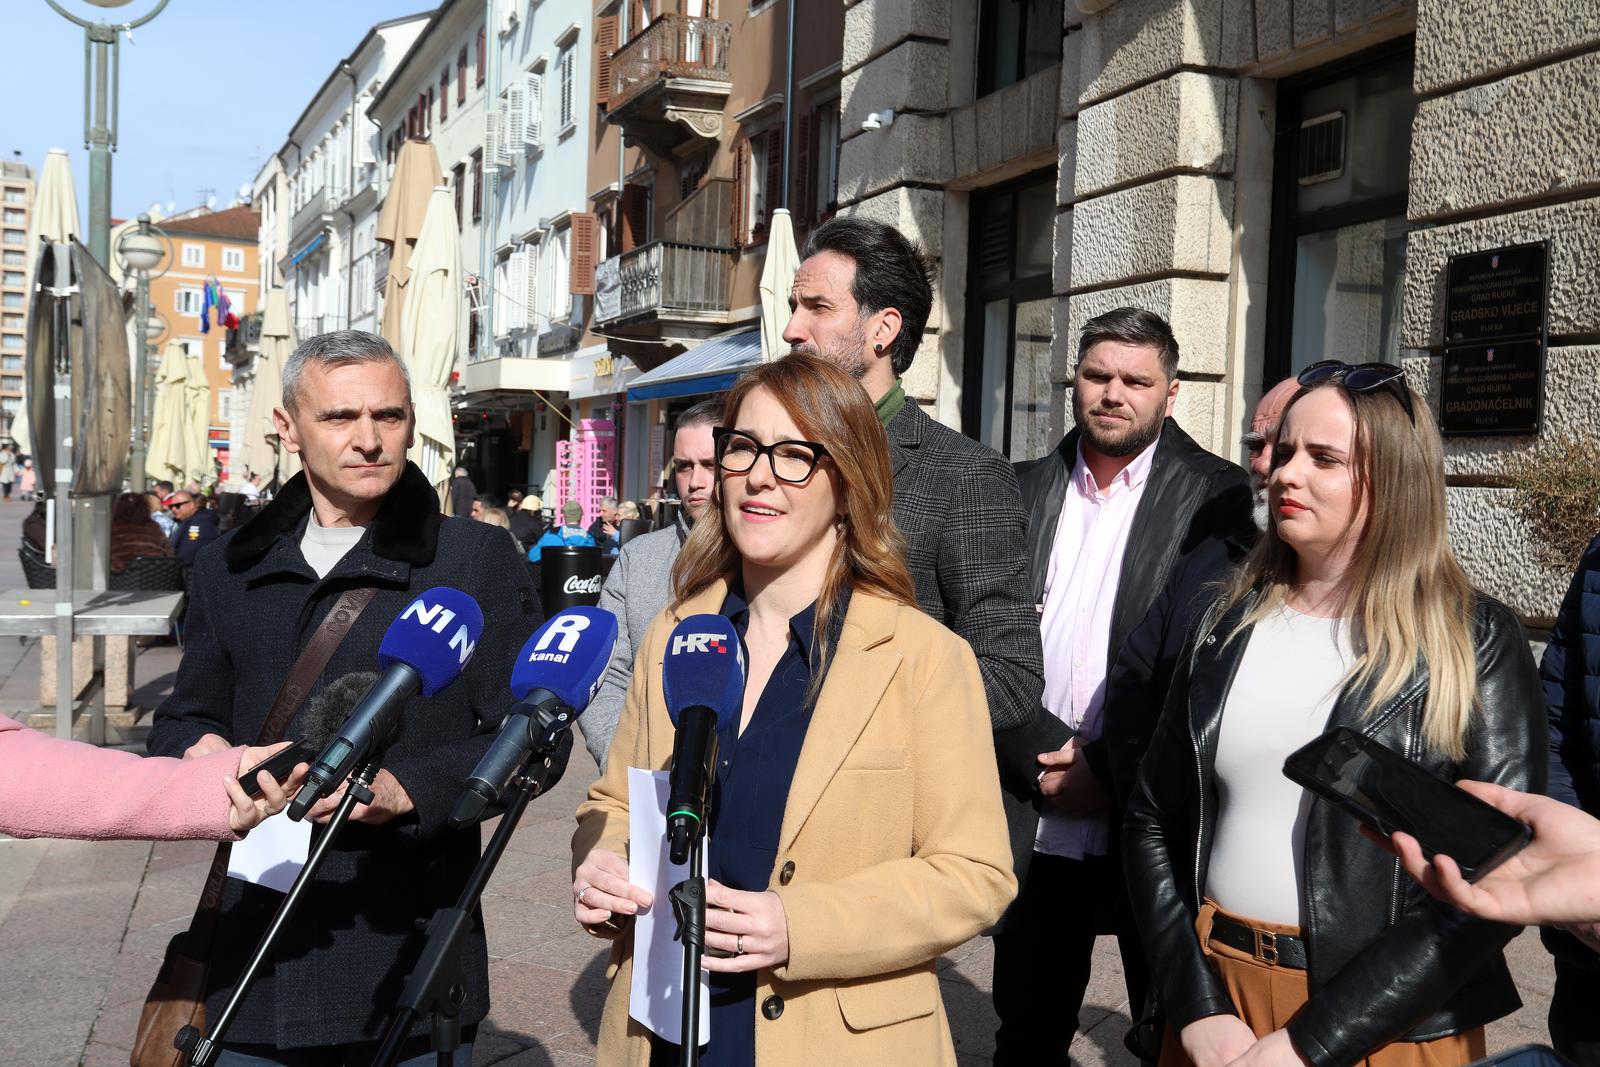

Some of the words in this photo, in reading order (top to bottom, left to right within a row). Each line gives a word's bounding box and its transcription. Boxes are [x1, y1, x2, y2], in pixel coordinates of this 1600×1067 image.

[1451, 305, 1499, 322] GRADSKO
[1502, 300, 1537, 315] VIJEĆE
[1446, 396, 1533, 412] GRADONAČELNIK
[400, 599, 456, 634] N1
[534, 614, 591, 652] R
[672, 633, 728, 654] HRT
[528, 652, 570, 664] kanal
[202, 862, 225, 908] ORLD
